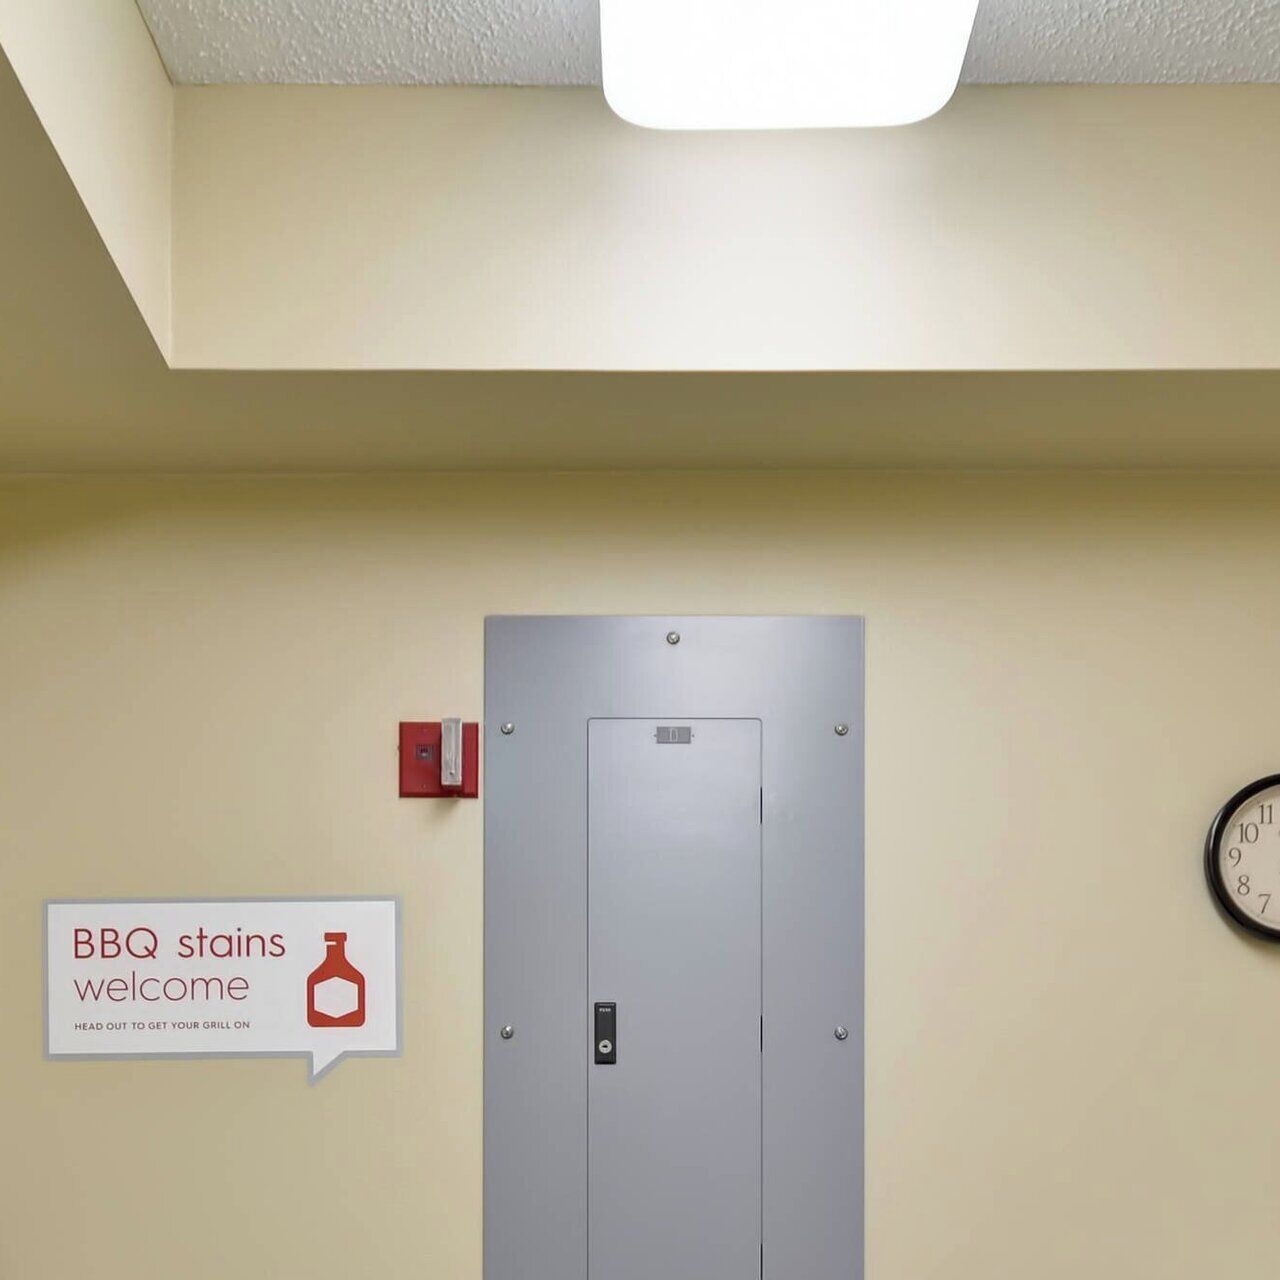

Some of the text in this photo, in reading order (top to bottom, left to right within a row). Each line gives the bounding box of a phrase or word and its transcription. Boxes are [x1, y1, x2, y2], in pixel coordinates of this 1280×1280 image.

[1258, 804, 1273, 824] 11
[1239, 822, 1259, 844] 10
[1228, 847, 1242, 867] 9
[1237, 874, 1250, 896] 8
[1258, 893, 1271, 914] 7
[73, 926, 287, 960] BBQ stains
[73, 970, 250, 1003] welcome
[74, 1020, 251, 1031] HEAD OUT TO GET YOUR GRILL ON
